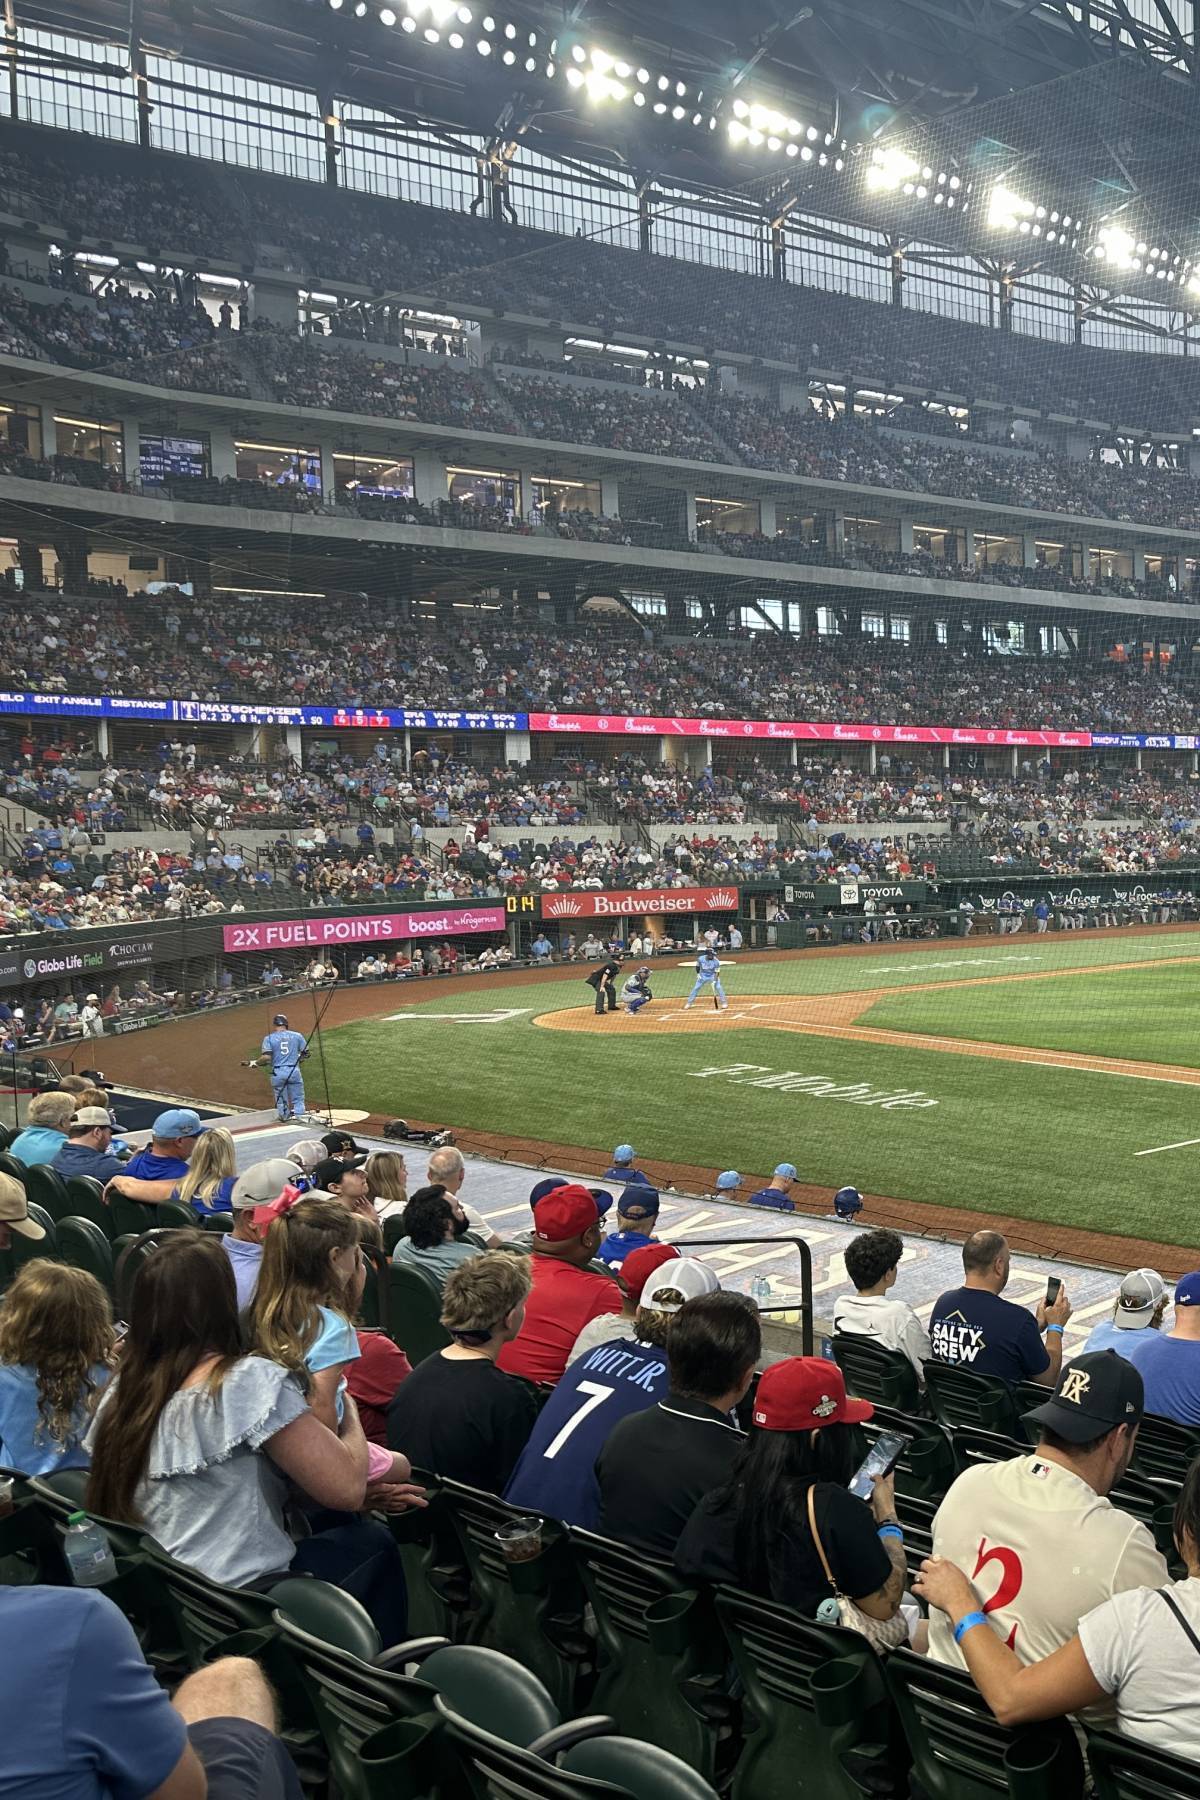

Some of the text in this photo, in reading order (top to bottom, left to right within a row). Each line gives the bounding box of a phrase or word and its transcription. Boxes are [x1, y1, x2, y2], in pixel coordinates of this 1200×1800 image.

[34, 695, 102, 706] EXIT ANGLE
[110, 699, 167, 710] DISTANCE
[182, 702, 197, 719] T
[200, 703, 302, 716] MAX SCHERZER
[403, 711, 426, 719] ERA
[433, 712, 461, 720] WHIP
[200, 713, 216, 722] 0.2
[404, 719, 426, 727] 0.00
[437, 720, 459, 728] 0.00
[470, 720, 486, 728] 0.0
[794, 890, 815, 900] TOYOTA
[862, 886, 904, 898] TOYOTA
[1130, 885, 1163, 901] Krog
[593, 895, 696, 914] Budweiser
[233, 919, 393, 946] 2X FUEL POINTS
[113, 942, 155, 957] CHOCTAW
[38, 958, 65, 974] Globe
[66, 955, 83, 969] Life
[83, 951, 103, 967] Field
[280, 1041, 289, 1055] 5
[933, 1323, 983, 1346] SALTY
[933, 1339, 980, 1362] CREW
[582, 1347, 666, 1392] WITT JR.
[543, 1380, 616, 1459] 7
